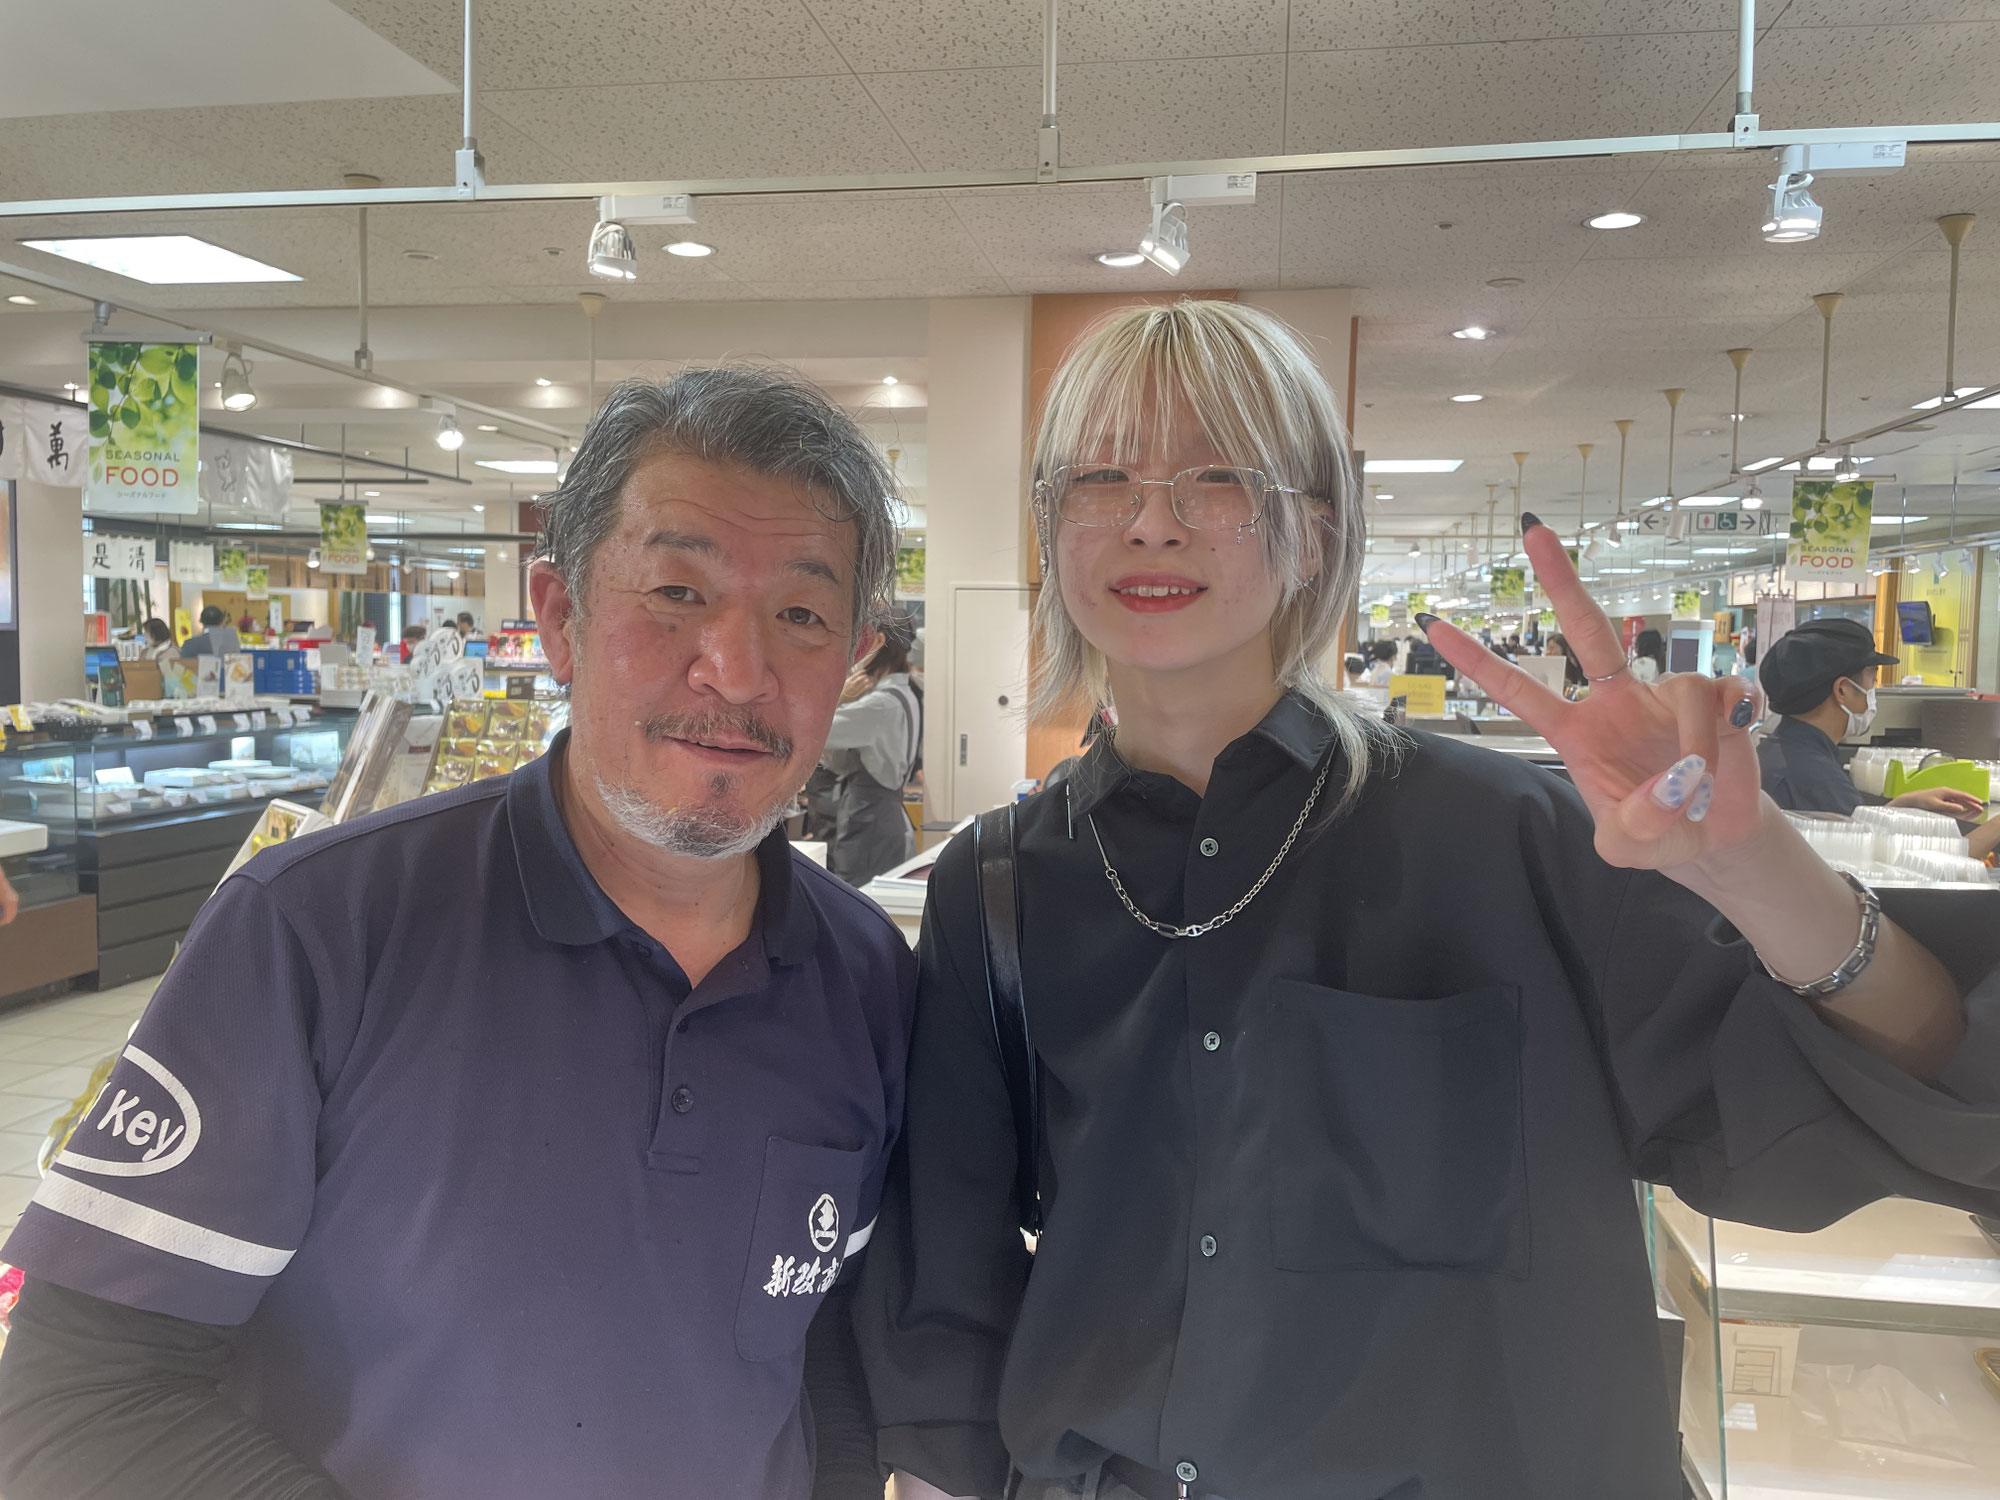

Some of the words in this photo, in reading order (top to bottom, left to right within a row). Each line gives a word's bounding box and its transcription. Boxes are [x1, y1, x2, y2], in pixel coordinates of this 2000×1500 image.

[47, 420, 69, 471] 萬
[105, 450, 181, 463] SEASONAL
[105, 466, 179, 487] FOOD
[1800, 545, 1857, 554] SEASONAL
[328, 553, 361, 564] FOOD
[1799, 555, 1854, 569] FOOD
[97, 1088, 185, 1162] Key
